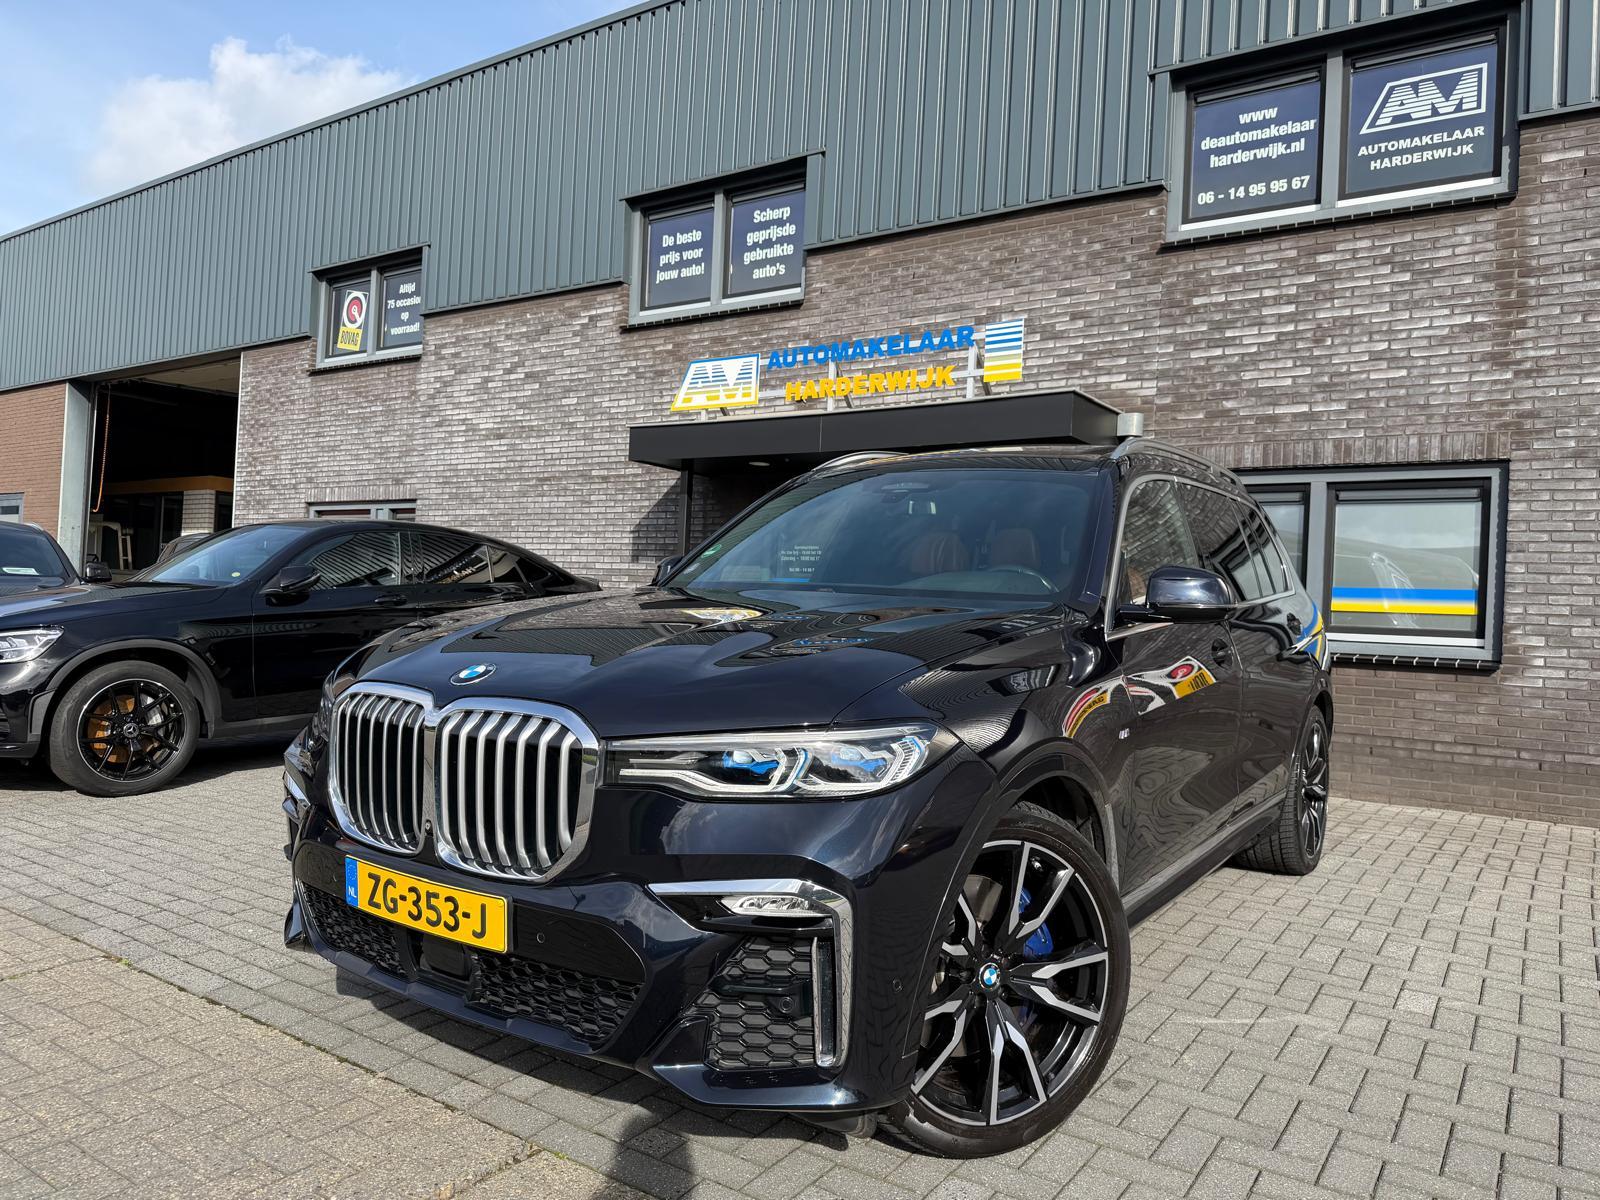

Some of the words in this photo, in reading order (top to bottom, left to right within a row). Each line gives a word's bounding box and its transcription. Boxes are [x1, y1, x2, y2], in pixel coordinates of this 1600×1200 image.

[1375, 71, 1478, 126] AM
[1239, 106, 1278, 125] www
[1201, 118, 1317, 150] deautomakelaar
[1358, 126, 1485, 156] AUTOMAKELAAR
[1209, 139, 1305, 168] harderwijk.nl
[1370, 143, 1474, 171] HARDERWIJK
[1198, 191, 1214, 205] 06
[1229, 187, 1245, 200] 14
[1248, 183, 1266, 197] 95
[1270, 179, 1288, 193] 95
[1292, 175, 1310, 189] 67
[753, 206, 791, 223] Scherp
[663, 235, 674, 247] De
[677, 230, 701, 244] beste
[747, 223, 796, 246] geprijsde
[660, 253, 680, 267] prijs
[683, 248, 703, 259] voor
[743, 244, 793, 264] gebruikte
[656, 269, 678, 284] jouw
[681, 264, 704, 276] auto!
[753, 263, 785, 279] auto's
[399, 282, 416, 294] Altijd
[387, 300, 395, 309] 75
[401, 312, 409, 322] op
[340, 330, 359, 345] BOVAG
[391, 323, 420, 335] voorraad!
[766, 326, 976, 370] AUTOMAKELAAR
[681, 360, 753, 403] AM
[785, 366, 957, 402] HARDERWIJK
[348, 886, 356, 898] NL
[368, 872, 486, 939] ZG-353-J
